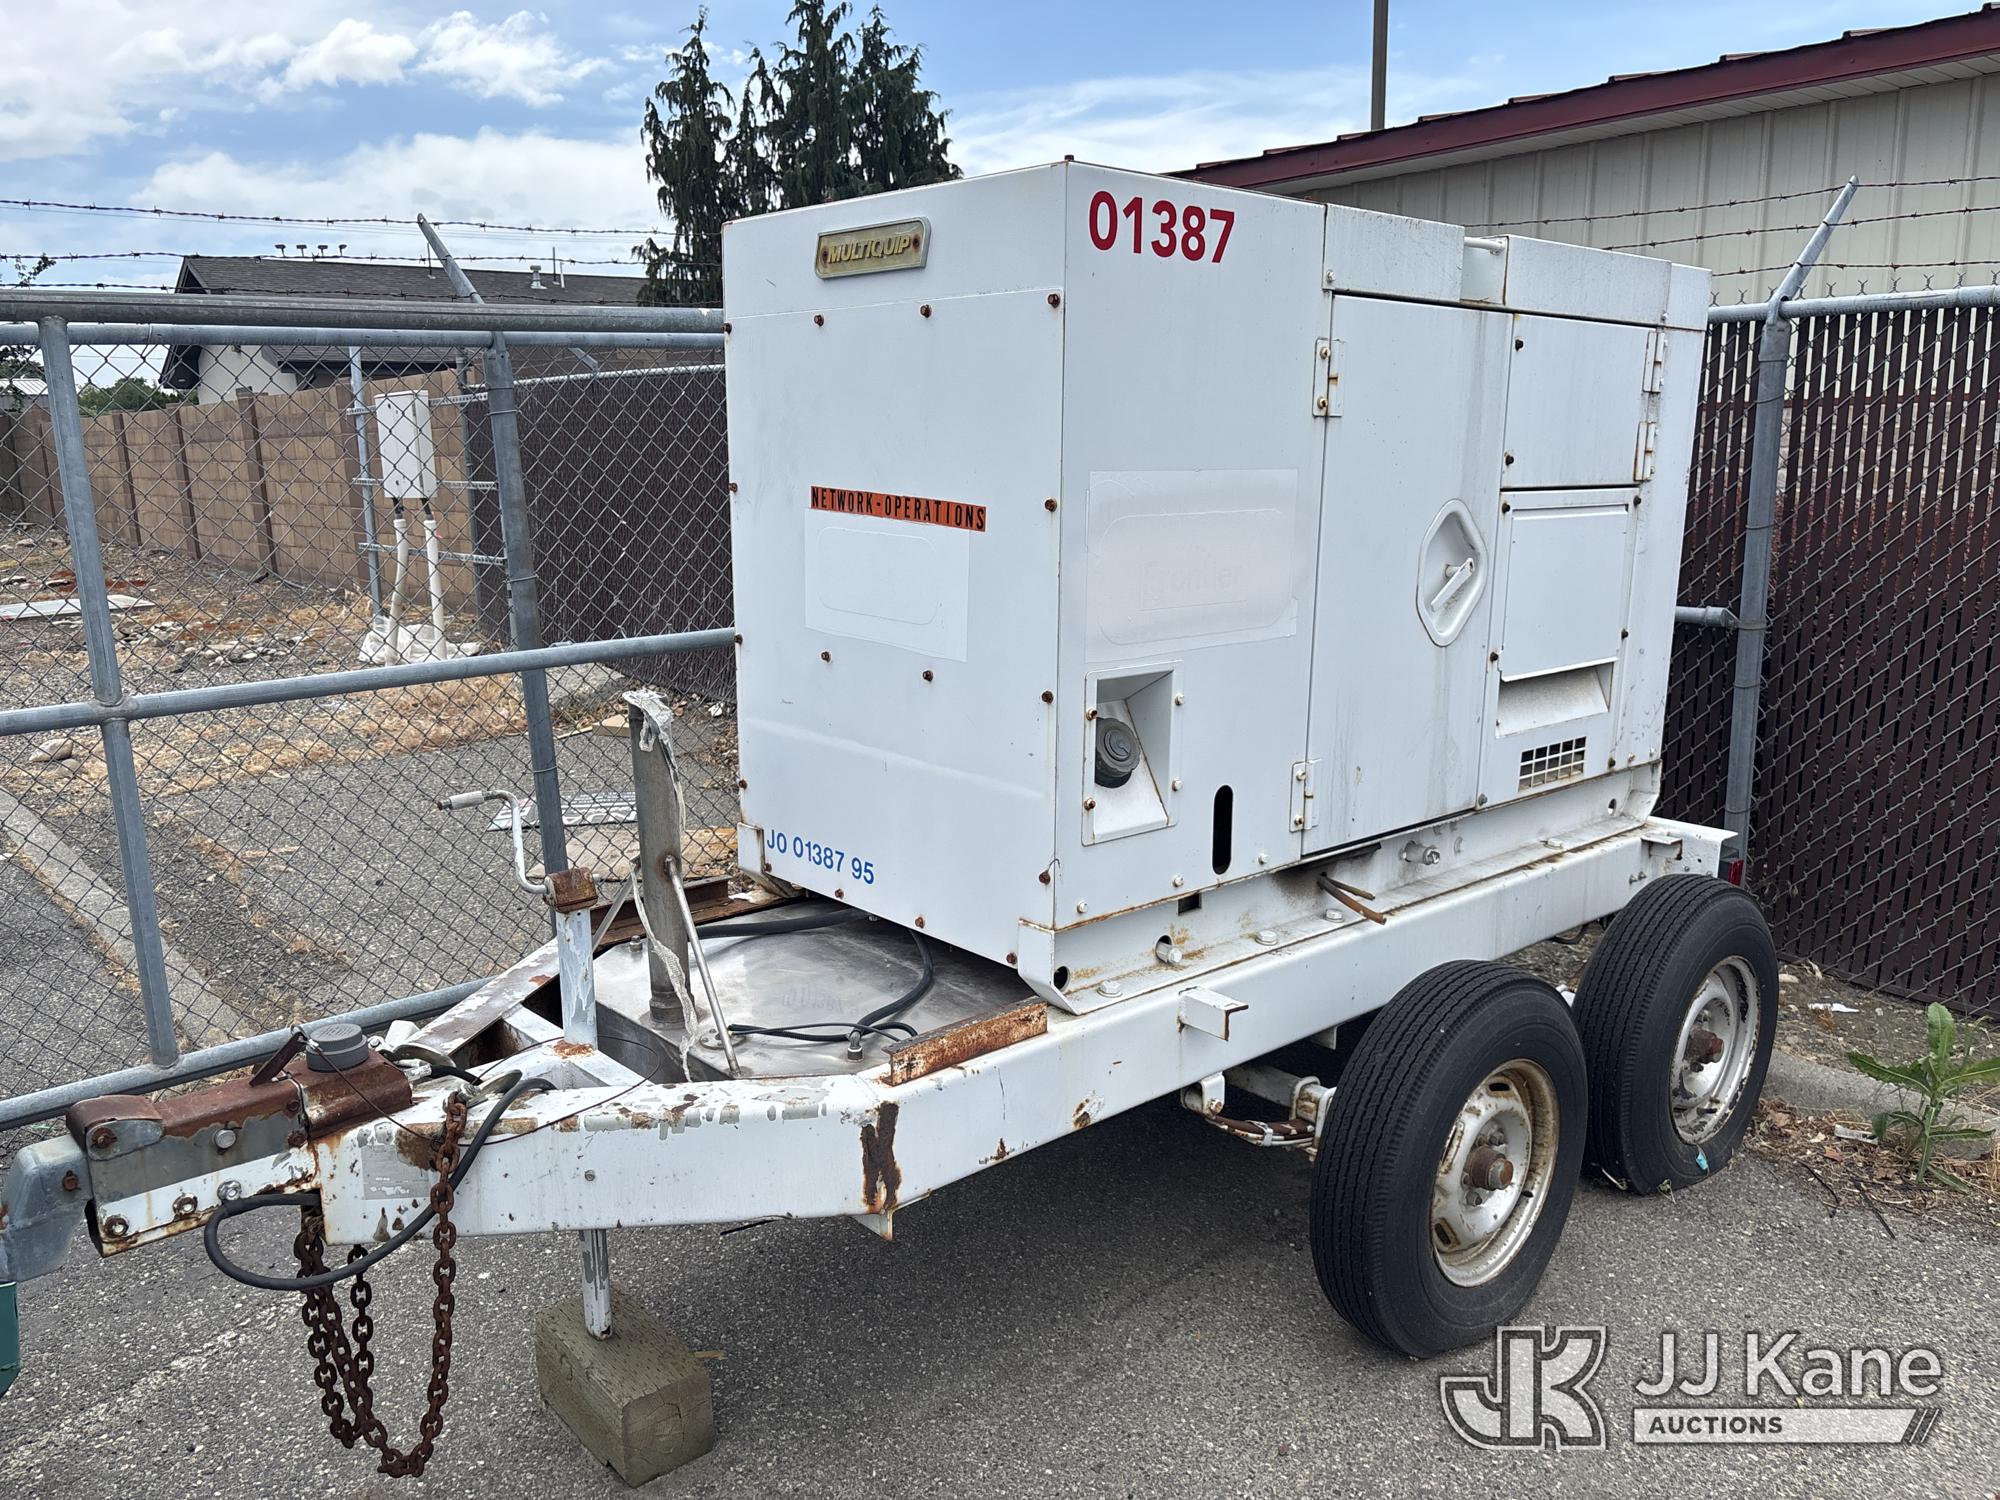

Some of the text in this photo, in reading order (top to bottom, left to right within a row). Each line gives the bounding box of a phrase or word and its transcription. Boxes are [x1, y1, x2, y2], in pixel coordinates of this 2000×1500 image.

[827, 235, 912, 264] MULTIQUIP
[1088, 190, 1236, 264] 01387
[792, 836, 845, 872] 01387
[851, 857, 875, 885] 95
